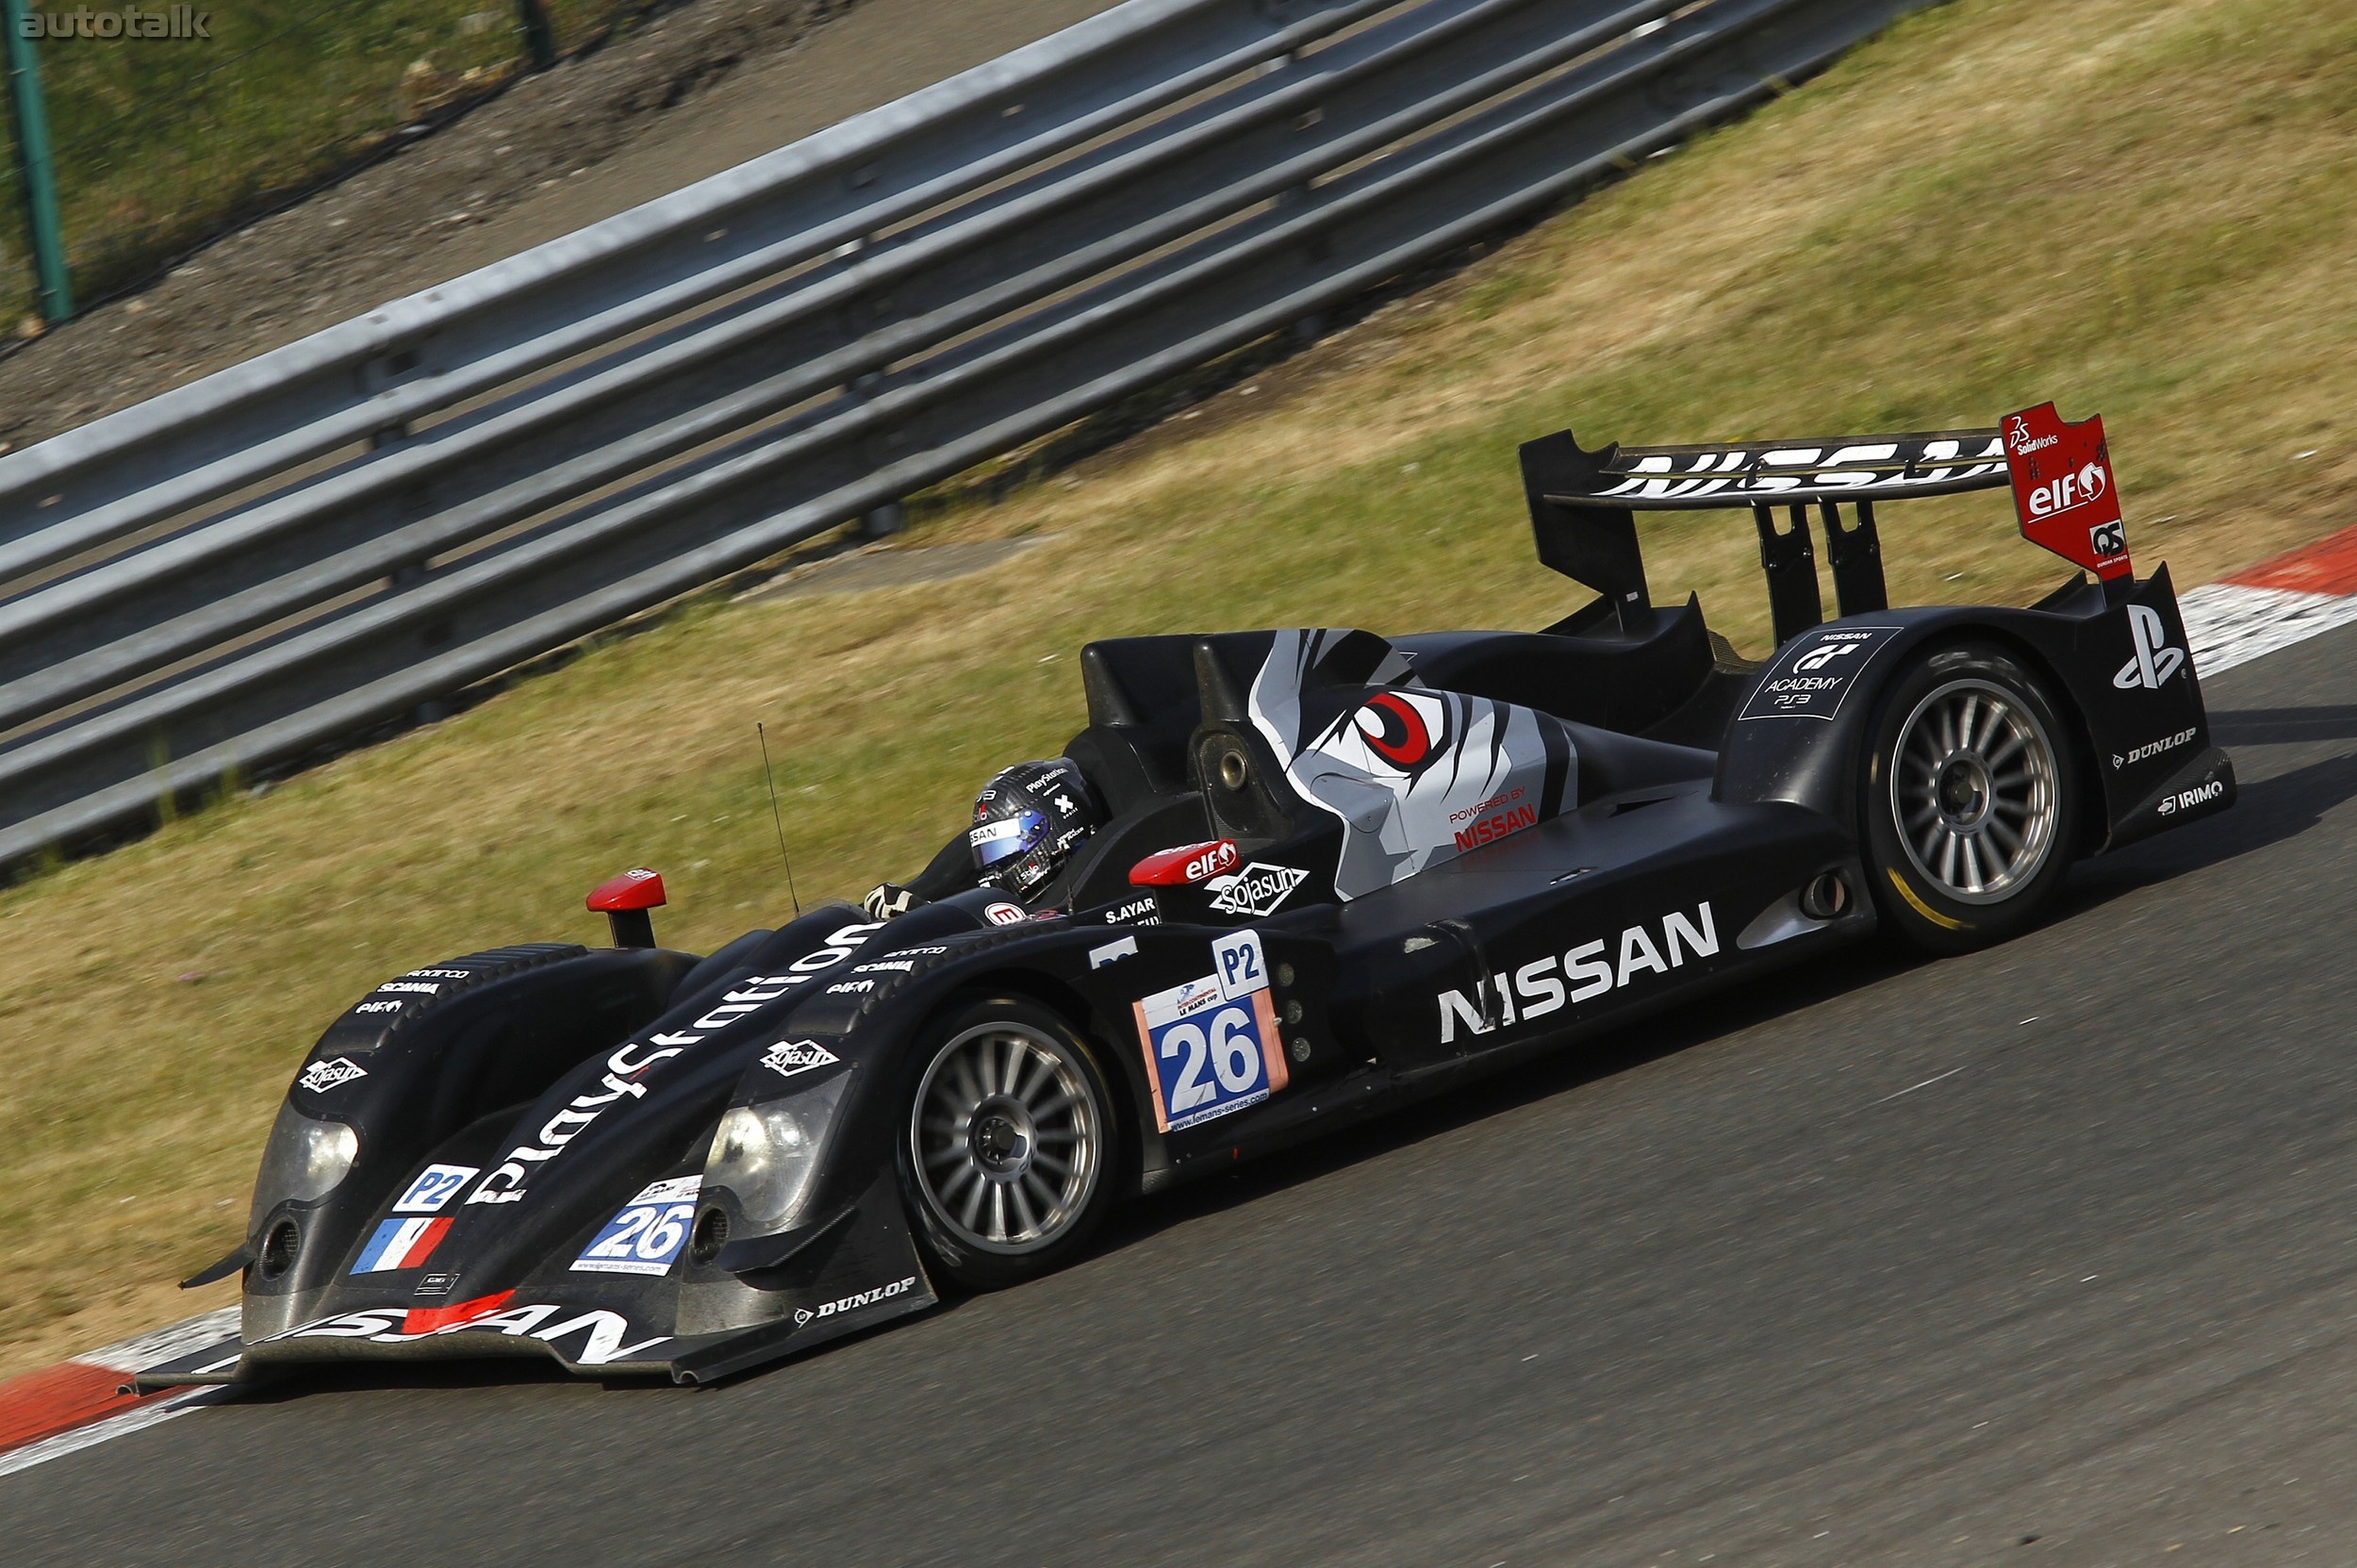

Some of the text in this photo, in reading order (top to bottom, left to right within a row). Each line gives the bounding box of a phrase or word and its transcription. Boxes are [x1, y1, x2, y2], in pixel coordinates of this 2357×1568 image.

[2017, 434, 2059, 456] SolidWorks
[2029, 472, 2075, 515] elf
[1820, 632, 1872, 641] NISSAN
[1764, 677, 1843, 693] ACADEMY
[1774, 694, 1811, 705] PS3
[2127, 727, 2197, 765] DUNLOP
[1026, 767, 1069, 793] PlayStation
[2179, 781, 2223, 809] IRIMO
[1449, 785, 1526, 824] POWERED BY
[1454, 802, 1537, 853] NISSAN
[1185, 850, 1219, 880] elf
[850, 960, 915, 974] SCANIA
[1222, 943, 1261, 985] P2
[1437, 900, 1721, 1044] NISSAN
[376, 982, 441, 995] SCANIA
[1188, 998, 1207, 1014] MANS
[464, 922, 888, 1205] PlayStation
[1161, 1007, 1261, 1115] 26
[1169, 1091, 1269, 1131] www.lemans-series.com
[403, 1172, 464, 1204] P2
[585, 1204, 696, 1260] 26
[816, 1276, 916, 1318] DUNLOP
